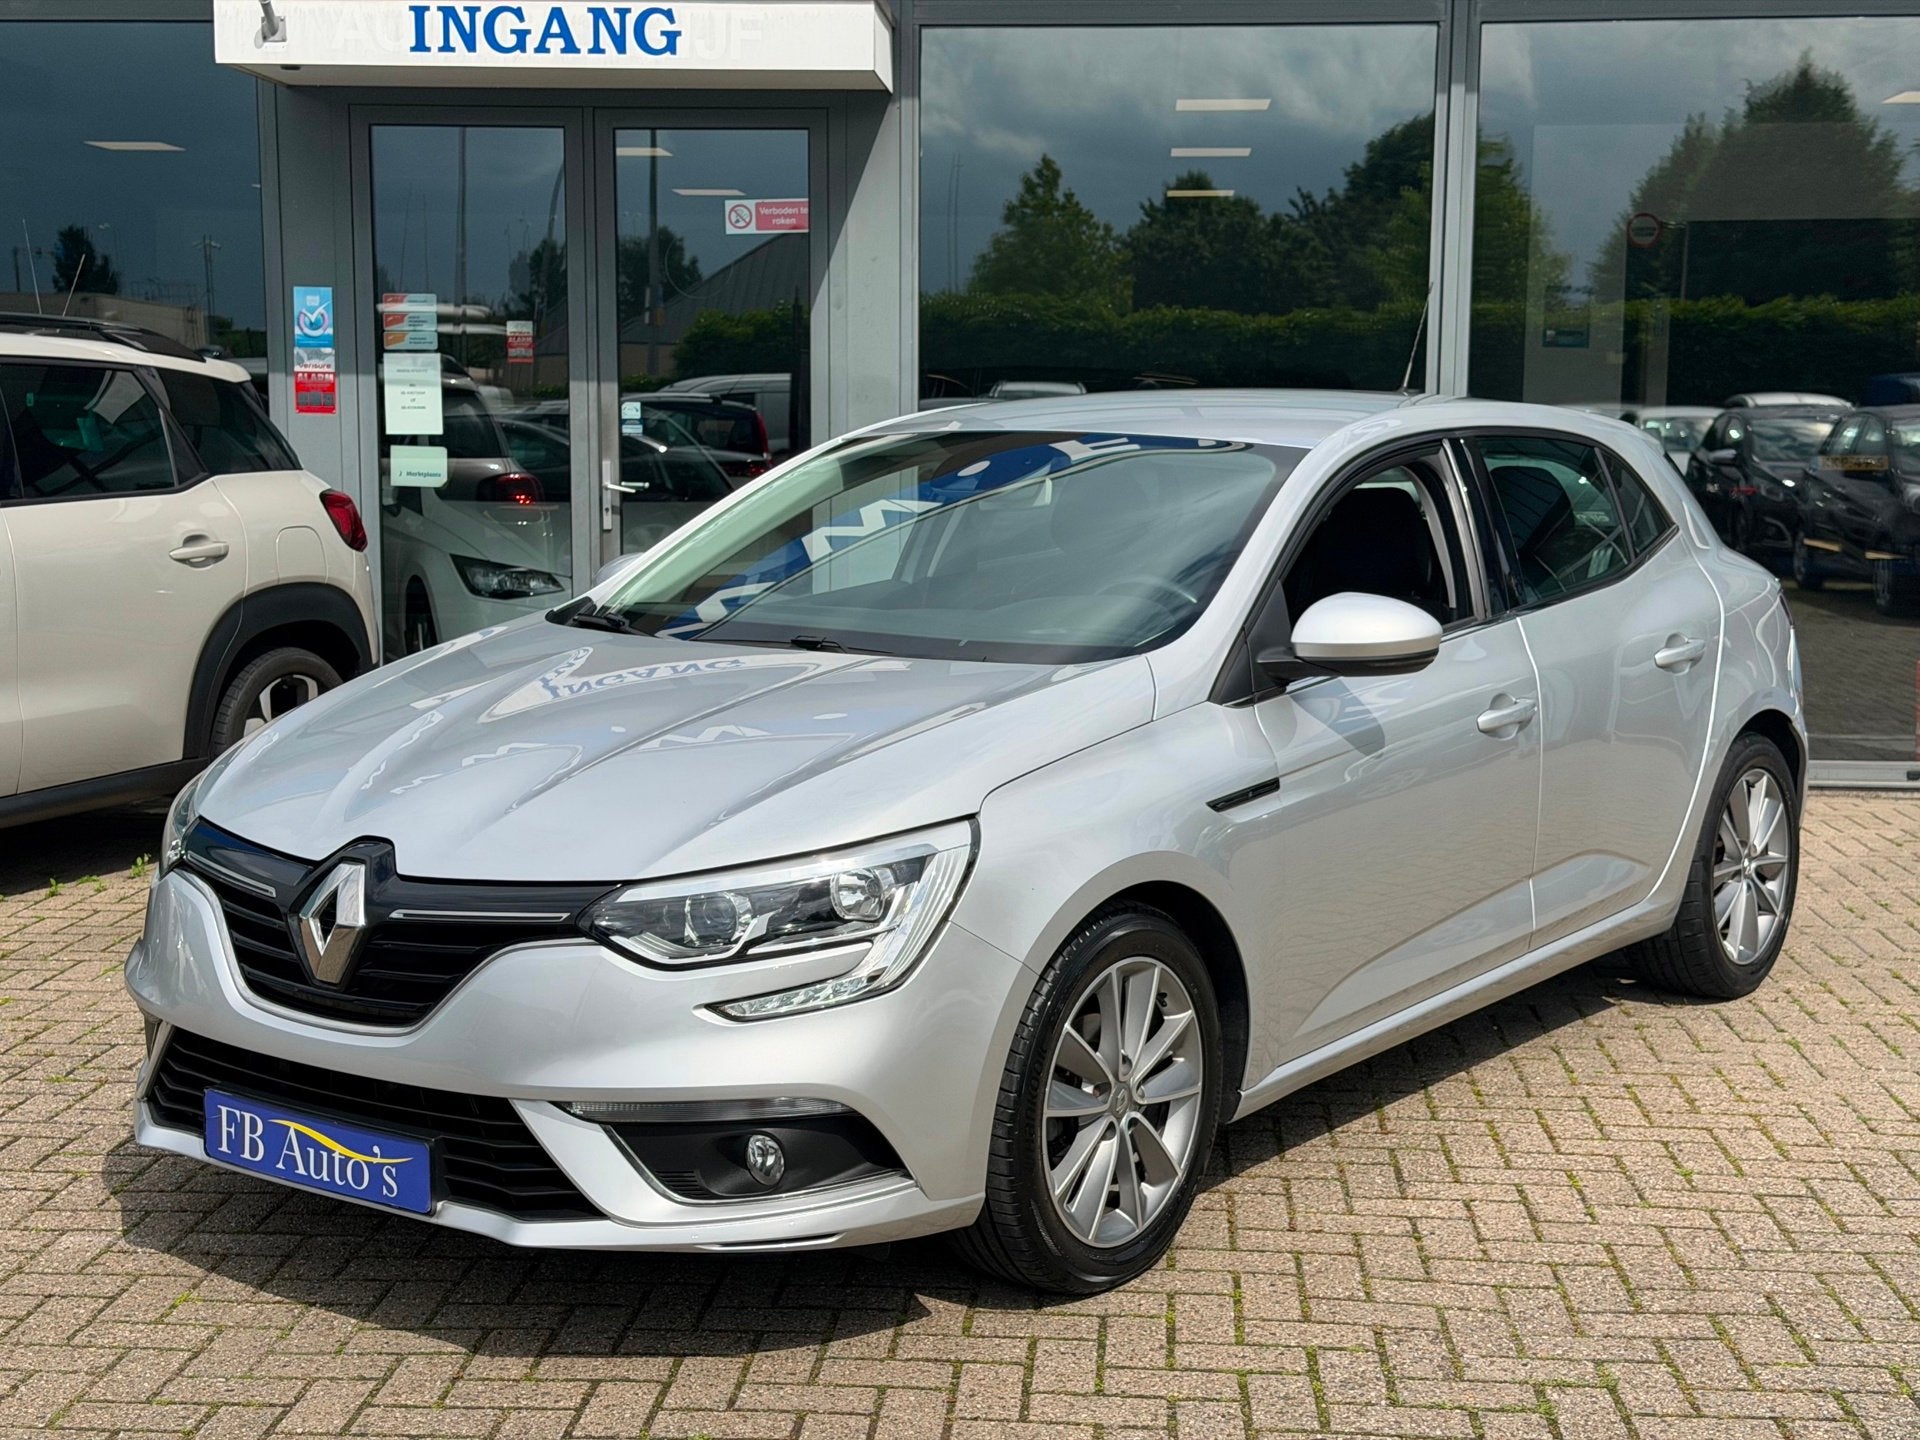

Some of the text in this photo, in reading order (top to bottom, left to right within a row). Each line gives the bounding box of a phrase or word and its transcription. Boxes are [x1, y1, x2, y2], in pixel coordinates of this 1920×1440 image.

[408, 5, 683, 56] INGANG
[759, 207, 799, 215] Verboden
[772, 217, 797, 225] roken
[299, 362, 332, 370] verisure
[297, 372, 335, 383] ALARM
[217, 1104, 399, 1198] FB Auto's
